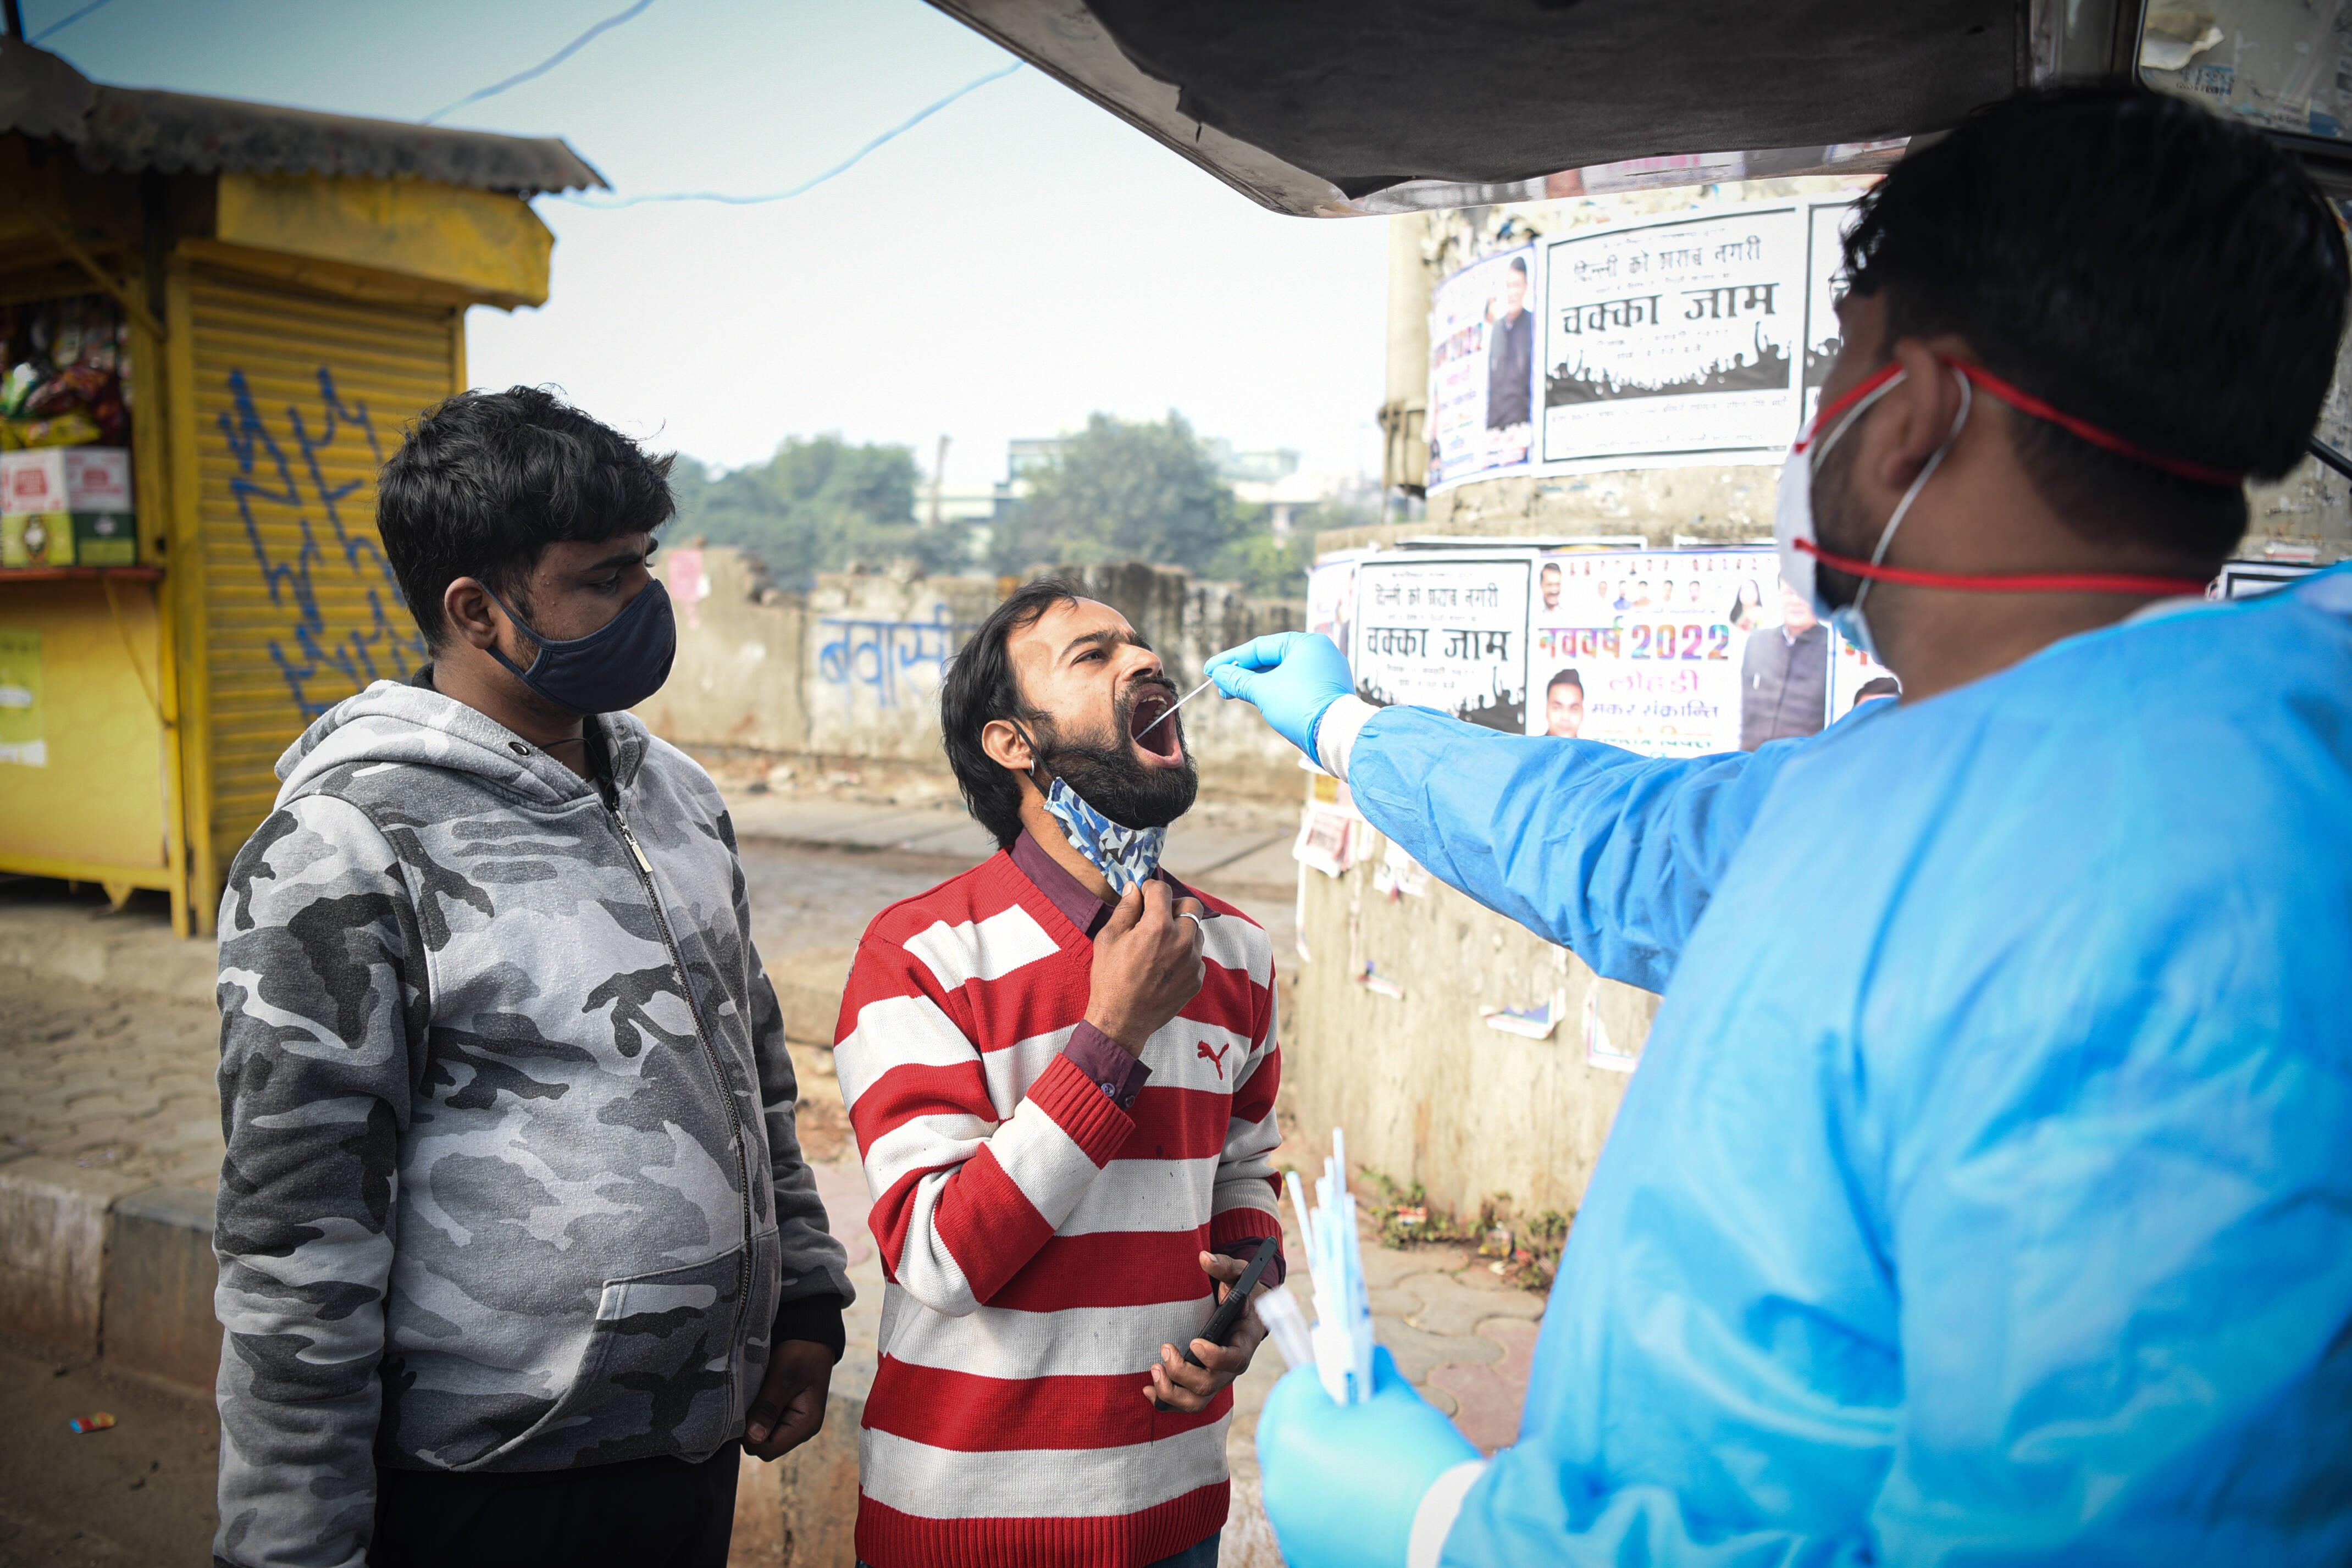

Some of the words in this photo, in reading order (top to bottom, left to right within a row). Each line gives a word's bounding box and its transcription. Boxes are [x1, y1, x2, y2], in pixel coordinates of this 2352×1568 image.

[1714, 235, 1761, 263] नगरी
[1561, 294, 1663, 334] चक्का
[1681, 282, 1780, 320] जाम
[1464, 583, 1498, 607] नगरी
[1366, 627, 1429, 658] चक्का
[1442, 628, 1512, 661] जाम
[1538, 615, 1624, 659] नववर्ष
[1630, 624, 1729, 660] 2022
[819, 603, 978, 707] बवासी
[1591, 703, 1636, 717] मकर
